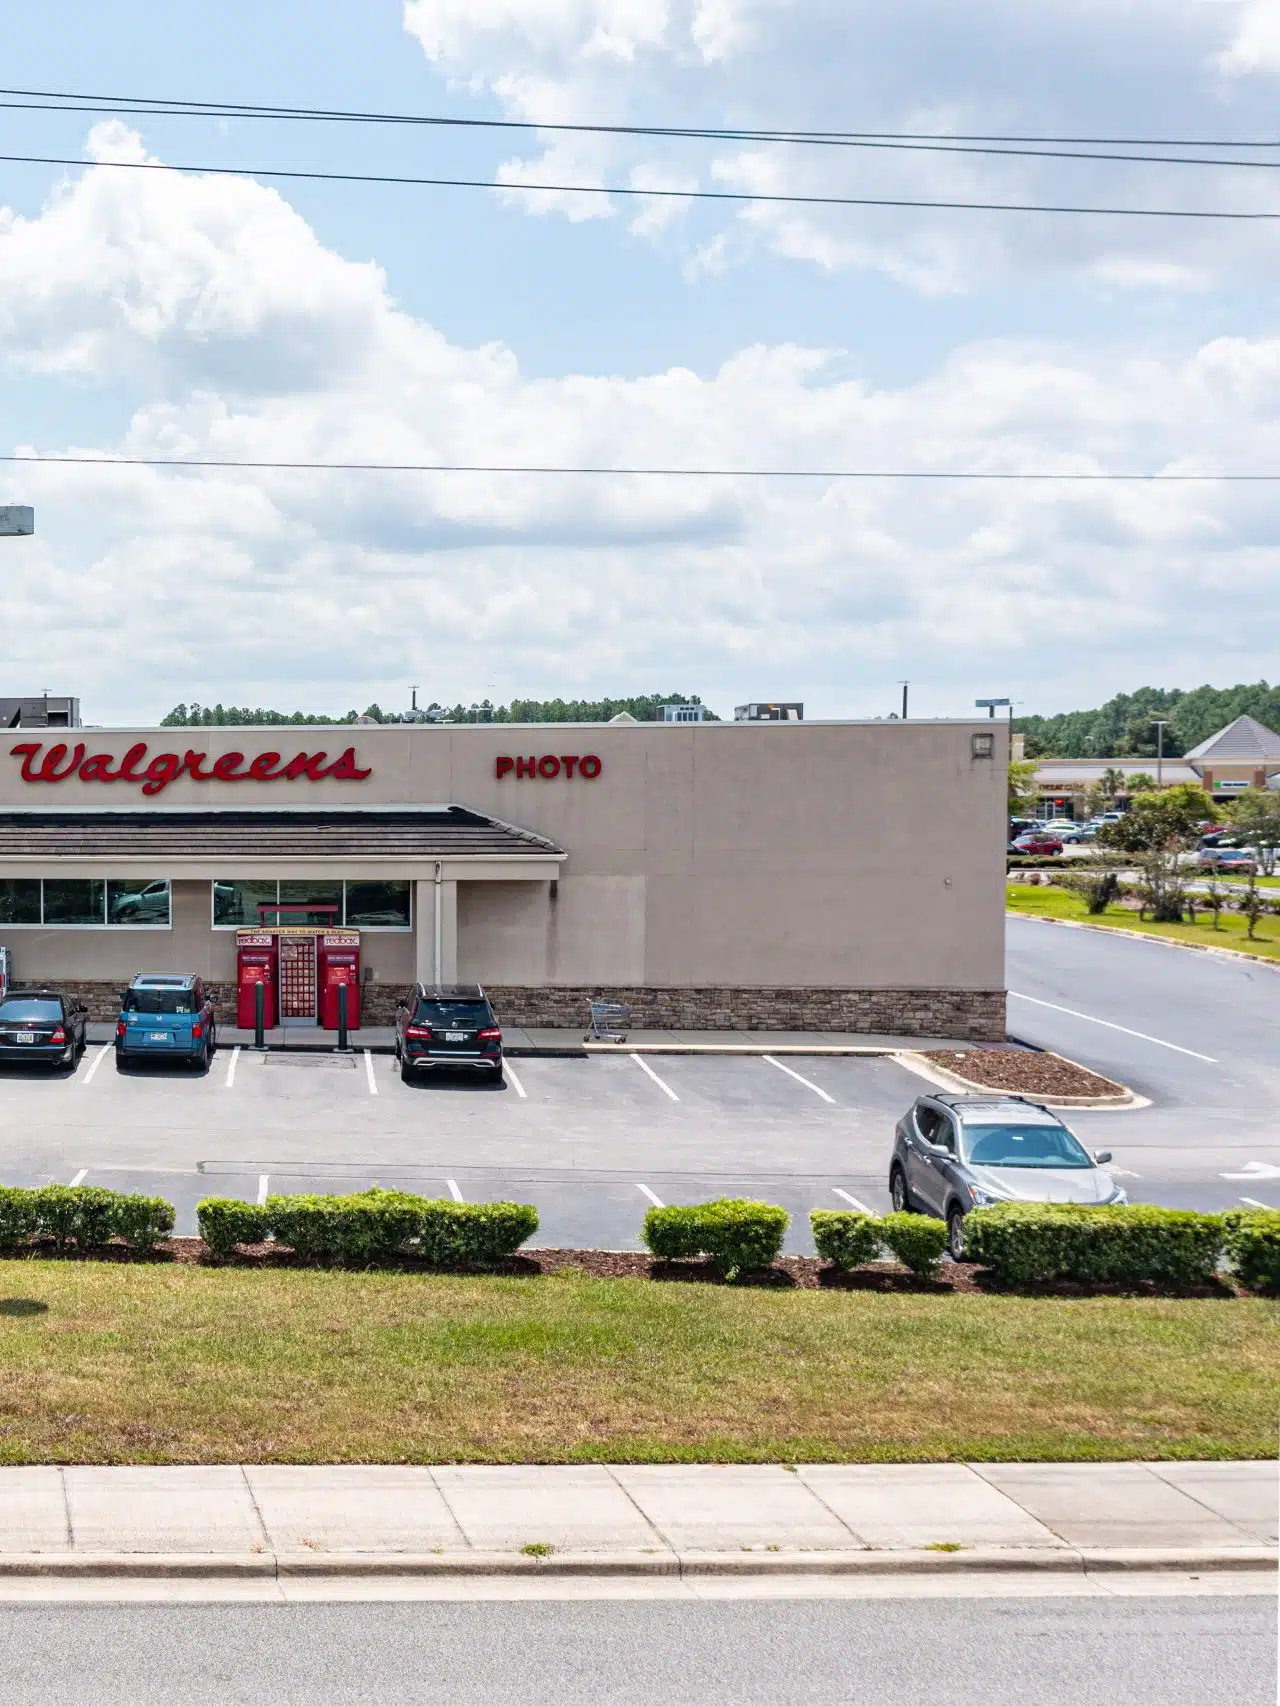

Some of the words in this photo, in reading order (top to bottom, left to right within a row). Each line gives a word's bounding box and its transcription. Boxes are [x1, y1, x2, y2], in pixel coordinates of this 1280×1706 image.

[10, 742, 372, 796] Walgreens
[496, 755, 602, 779] PHOTO
[325, 934, 357, 944] redbox
